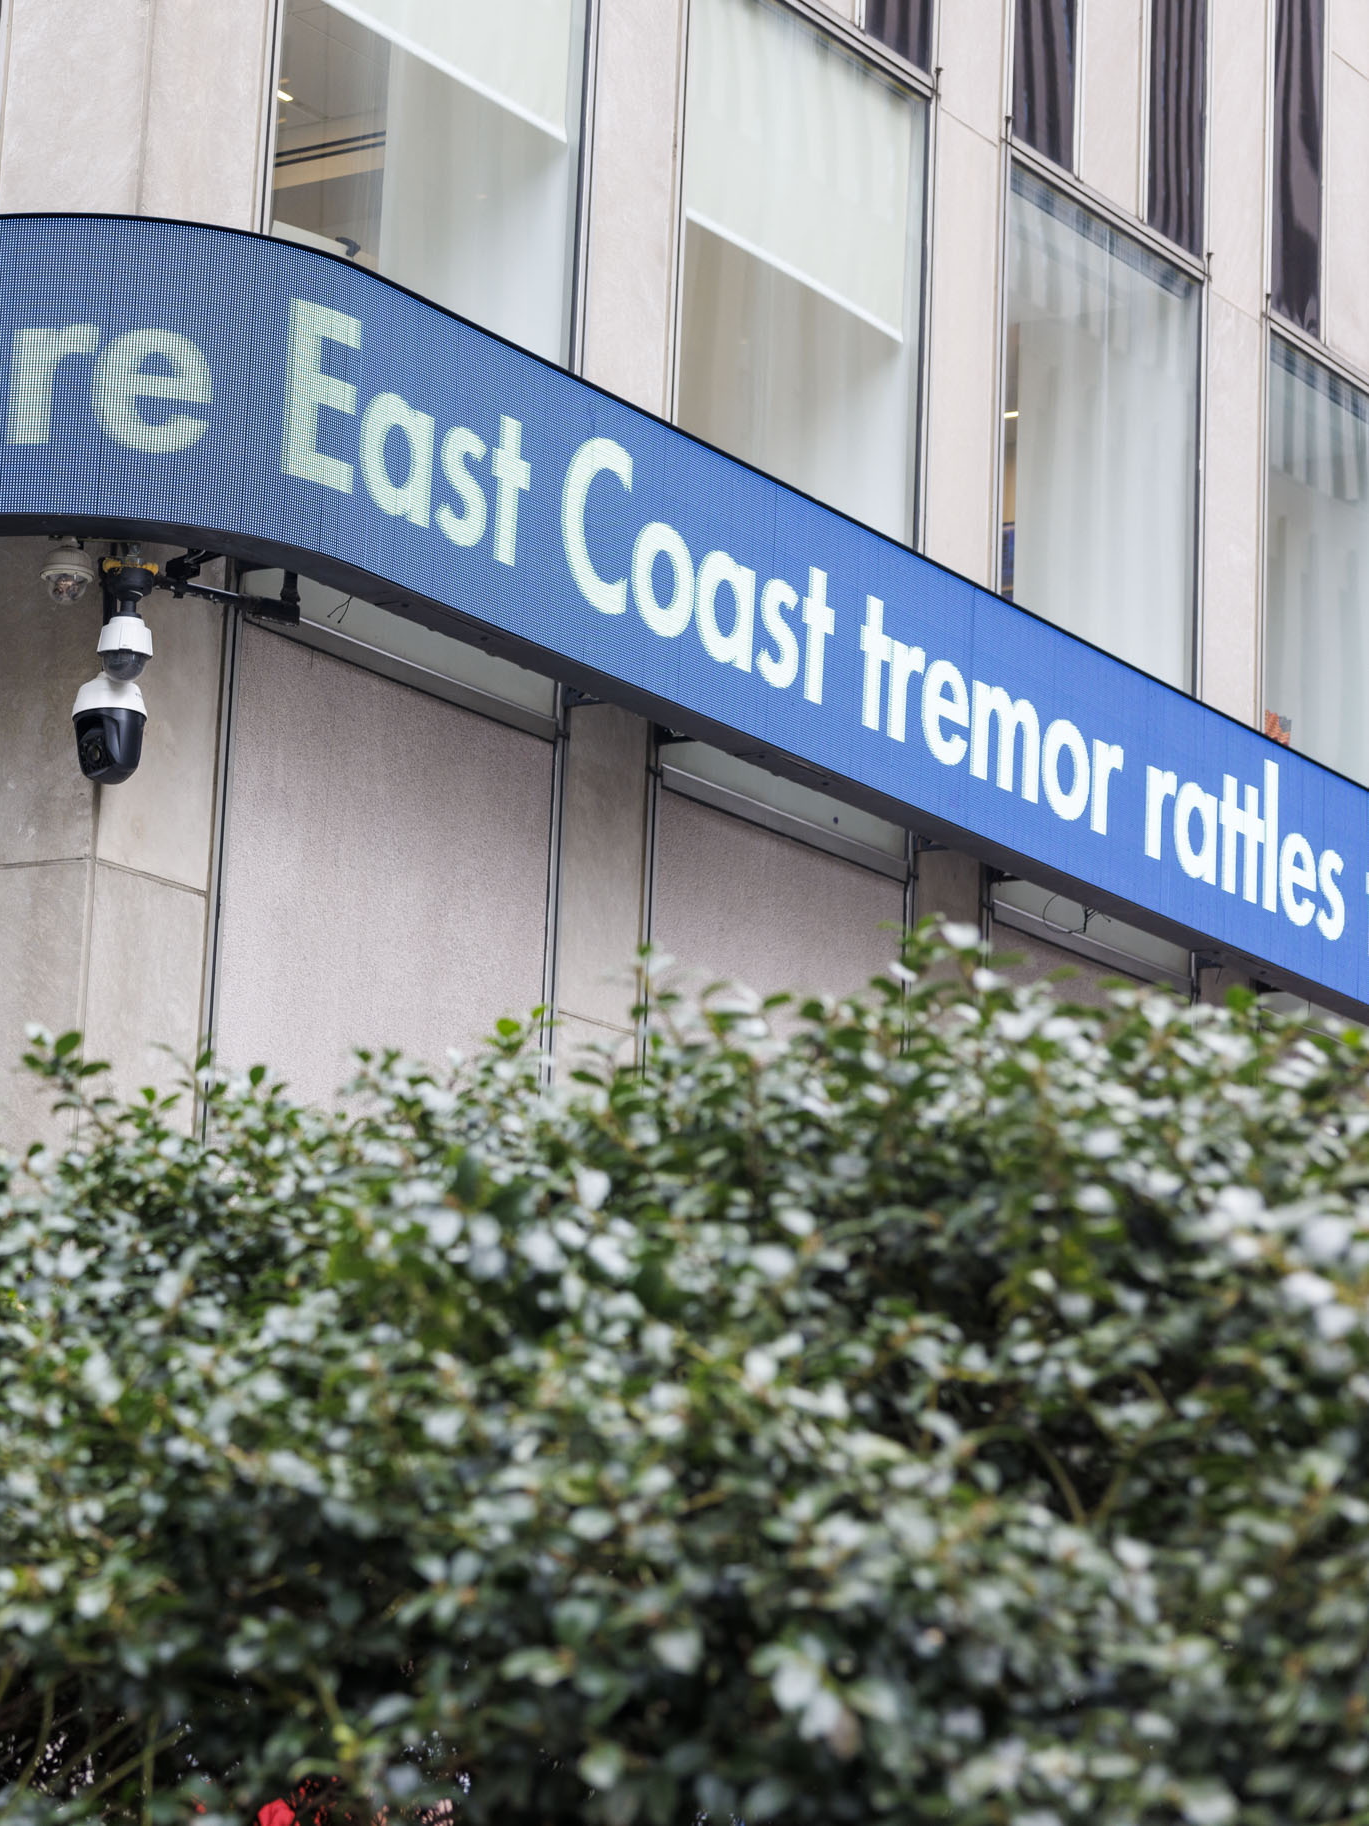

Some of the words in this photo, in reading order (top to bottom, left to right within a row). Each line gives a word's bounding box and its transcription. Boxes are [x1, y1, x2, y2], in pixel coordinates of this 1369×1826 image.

[282, 299, 533, 567] East
[560, 436, 836, 706] Coast
[860, 594, 1124, 836] tremor
[1143, 758, 1347, 942] rattles
